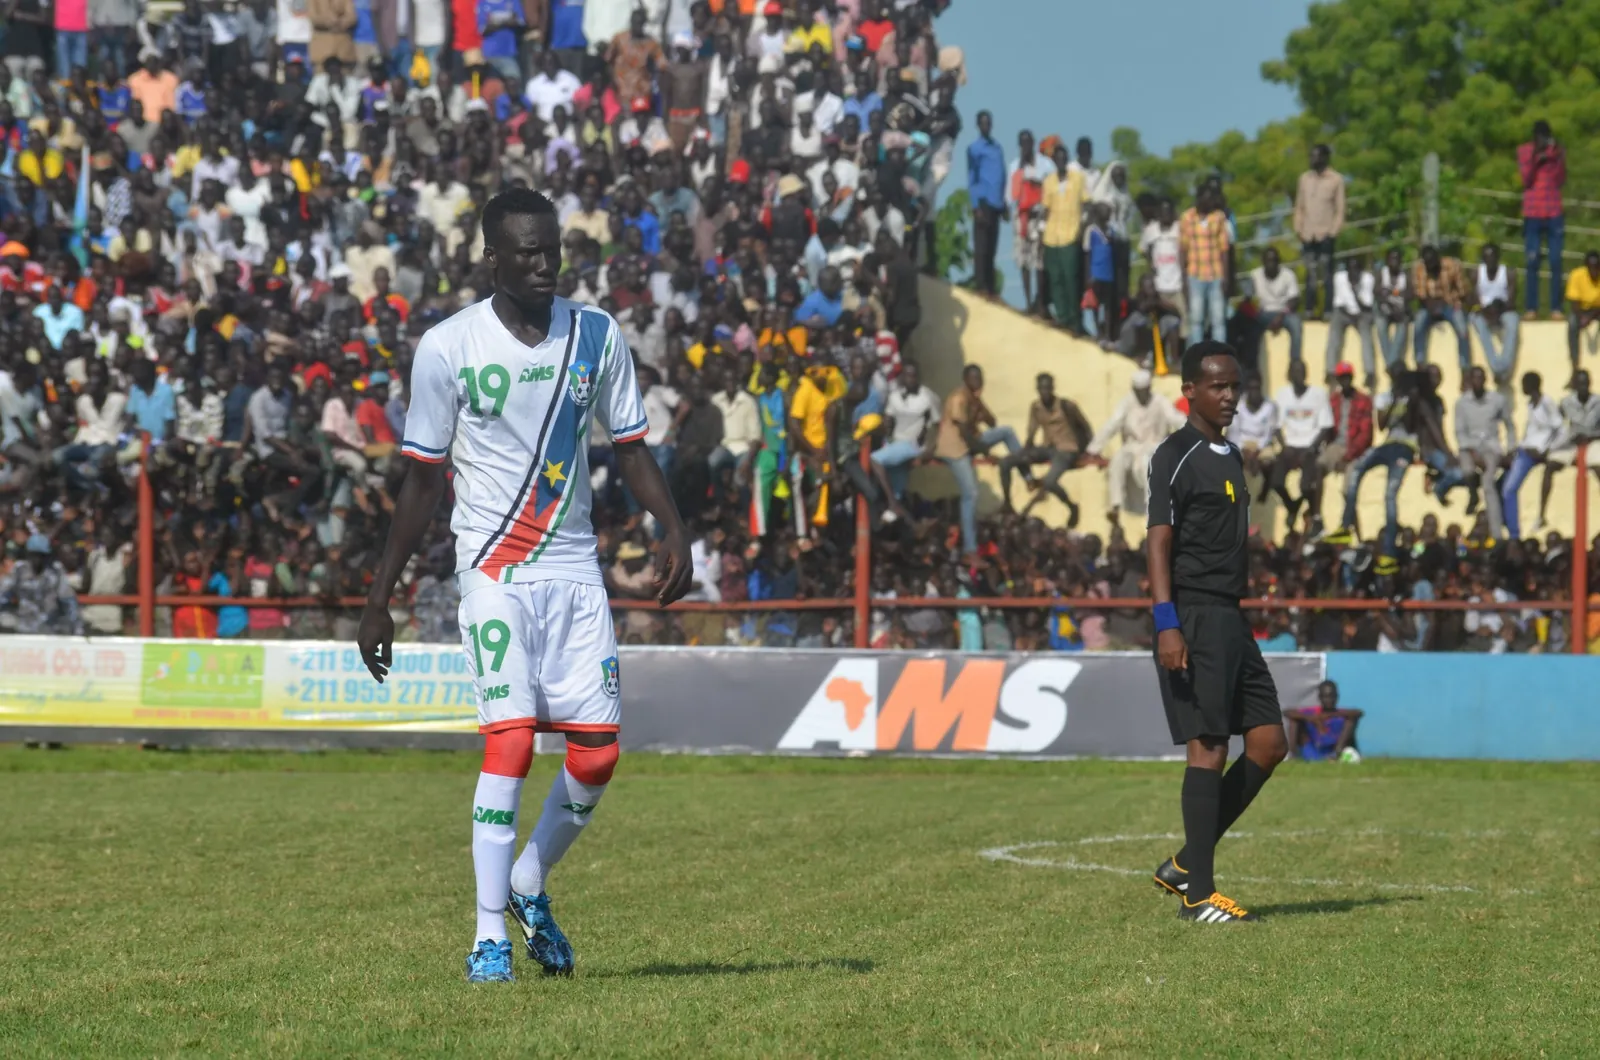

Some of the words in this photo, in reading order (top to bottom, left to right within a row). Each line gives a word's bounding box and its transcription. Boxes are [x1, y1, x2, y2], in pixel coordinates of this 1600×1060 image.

[458, 363, 511, 418] 19
[517, 365, 555, 383] AMS
[468, 618, 511, 677] 19
[343, 678, 392, 704] 955
[398, 680, 438, 704] 277
[776, 657, 1083, 753] AMS
